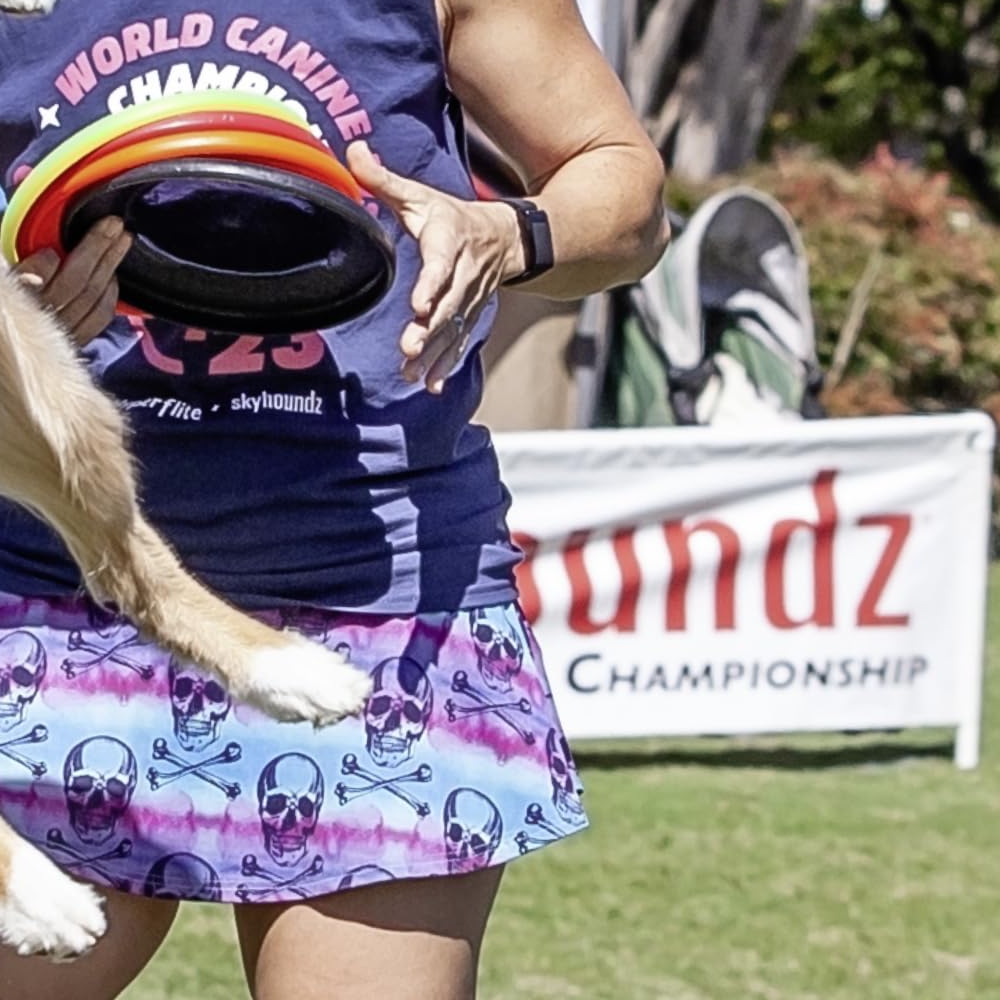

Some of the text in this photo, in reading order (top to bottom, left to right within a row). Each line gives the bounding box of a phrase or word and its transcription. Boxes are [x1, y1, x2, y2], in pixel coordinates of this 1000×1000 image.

[54, 12, 373, 141] WORLD CANINE
[231, 389, 323, 415] skyhoundz
[567, 653, 929, 694] CHAMPIONSHIP
